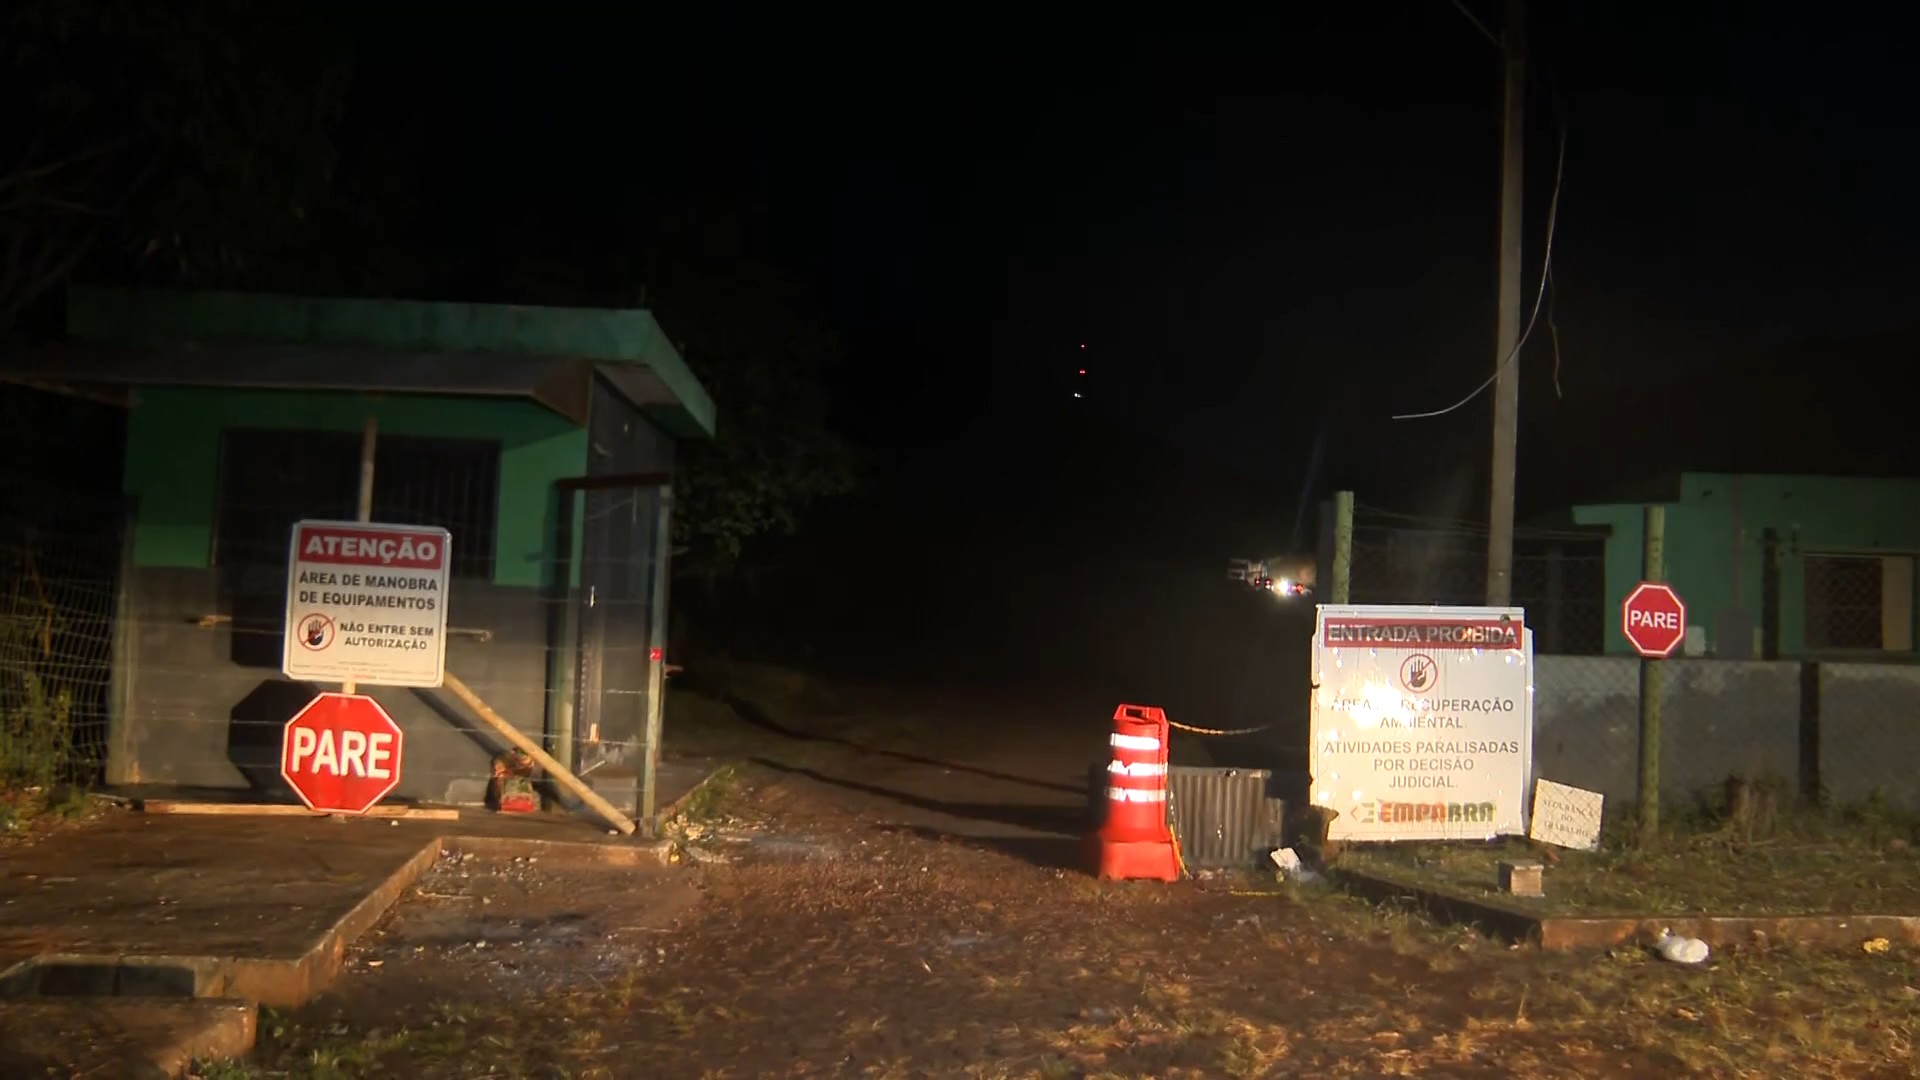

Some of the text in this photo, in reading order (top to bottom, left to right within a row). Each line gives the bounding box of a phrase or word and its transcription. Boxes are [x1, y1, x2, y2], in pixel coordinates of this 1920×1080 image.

[305, 536, 436, 563] ATENÇÃO
[299, 570, 438, 591] ÁREA DE MANOBRA
[299, 591, 435, 610] DE EQUIPAMENTOS
[340, 622, 434, 636] NÃO ENTRE SEM
[1630, 609, 1678, 630] PARE
[1328, 624, 1518, 644] ENTRADA PROIBIDA
[344, 636, 427, 652] AUTORIZAÇÃO
[1380, 717, 1467, 729] AMIENTAL.
[292, 727, 393, 779] PARE
[1324, 741, 1519, 754] ATIVIDADES PARALISADAS
[1374, 757, 1474, 771] POR DECISÃO
[1379, 801, 1494, 823] EMPABRA
